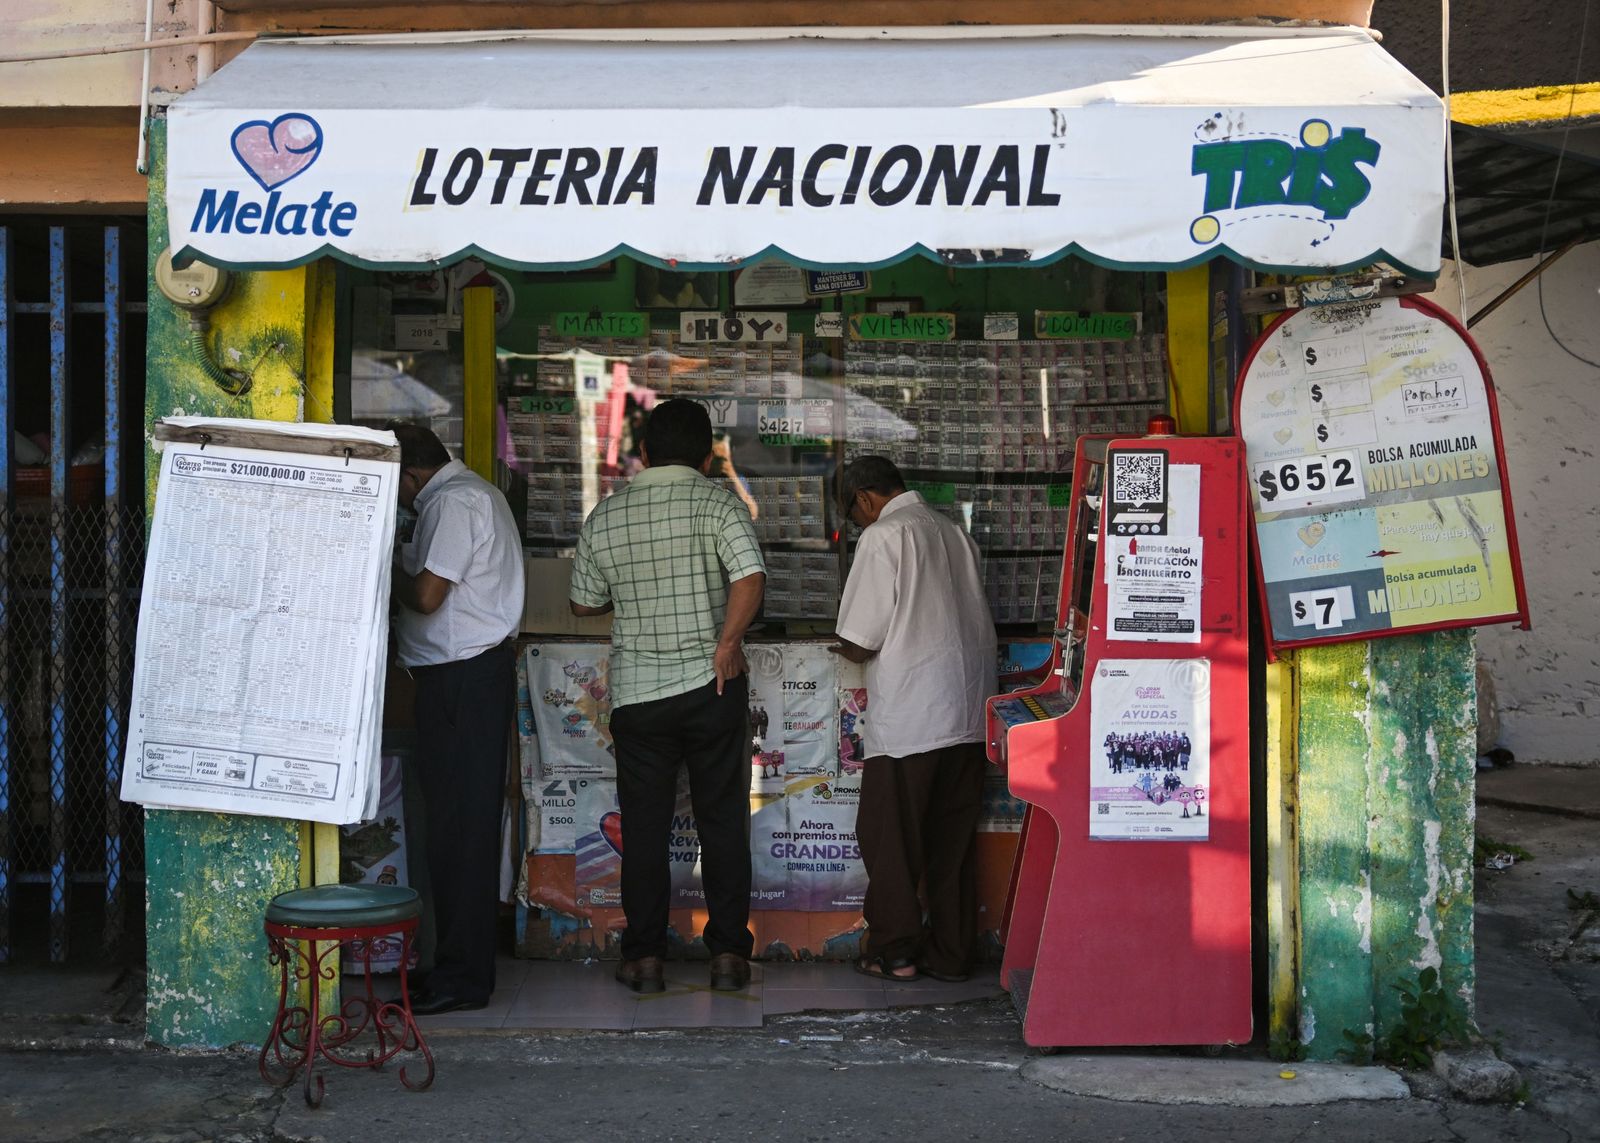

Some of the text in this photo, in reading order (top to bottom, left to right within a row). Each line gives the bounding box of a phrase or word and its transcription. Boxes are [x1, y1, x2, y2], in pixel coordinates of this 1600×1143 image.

[410, 144, 1061, 207] LOTERIA NACIONAL
[190, 189, 357, 237] Melate
[831, 280, 861, 289] DISTANCIA
[564, 316, 639, 333] MARTES
[695, 318, 774, 340] HOY
[866, 318, 946, 336] VIERNES
[1052, 317, 1132, 334] DOMINGO
[530, 402, 564, 411] HOY
[1368, 435, 1478, 464] BOLSA ACUMULADA
[231, 463, 305, 480] $21,000,000.00
[1258, 458, 1355, 502] $652
[1368, 454, 1490, 495] MILLONES
[1460, 523, 1496, 540] juar!
[1117, 555, 1198, 567] CTIFICACIÓN
[1292, 551, 1340, 567] Melate
[1386, 564, 1477, 584] Bolsa acumulada
[1368, 578, 1482, 614] MILLONES
[1122, 710, 1178, 719] AYUDAS
[800, 820, 834, 830] Ahora
[794, 831, 837, 841] premios
[839, 832, 858, 840] má
[770, 843, 862, 860] GRANDES
[787, 861, 845, 872] COMPRA EN LÍNEA
[759, 890, 785, 900] jugar!
